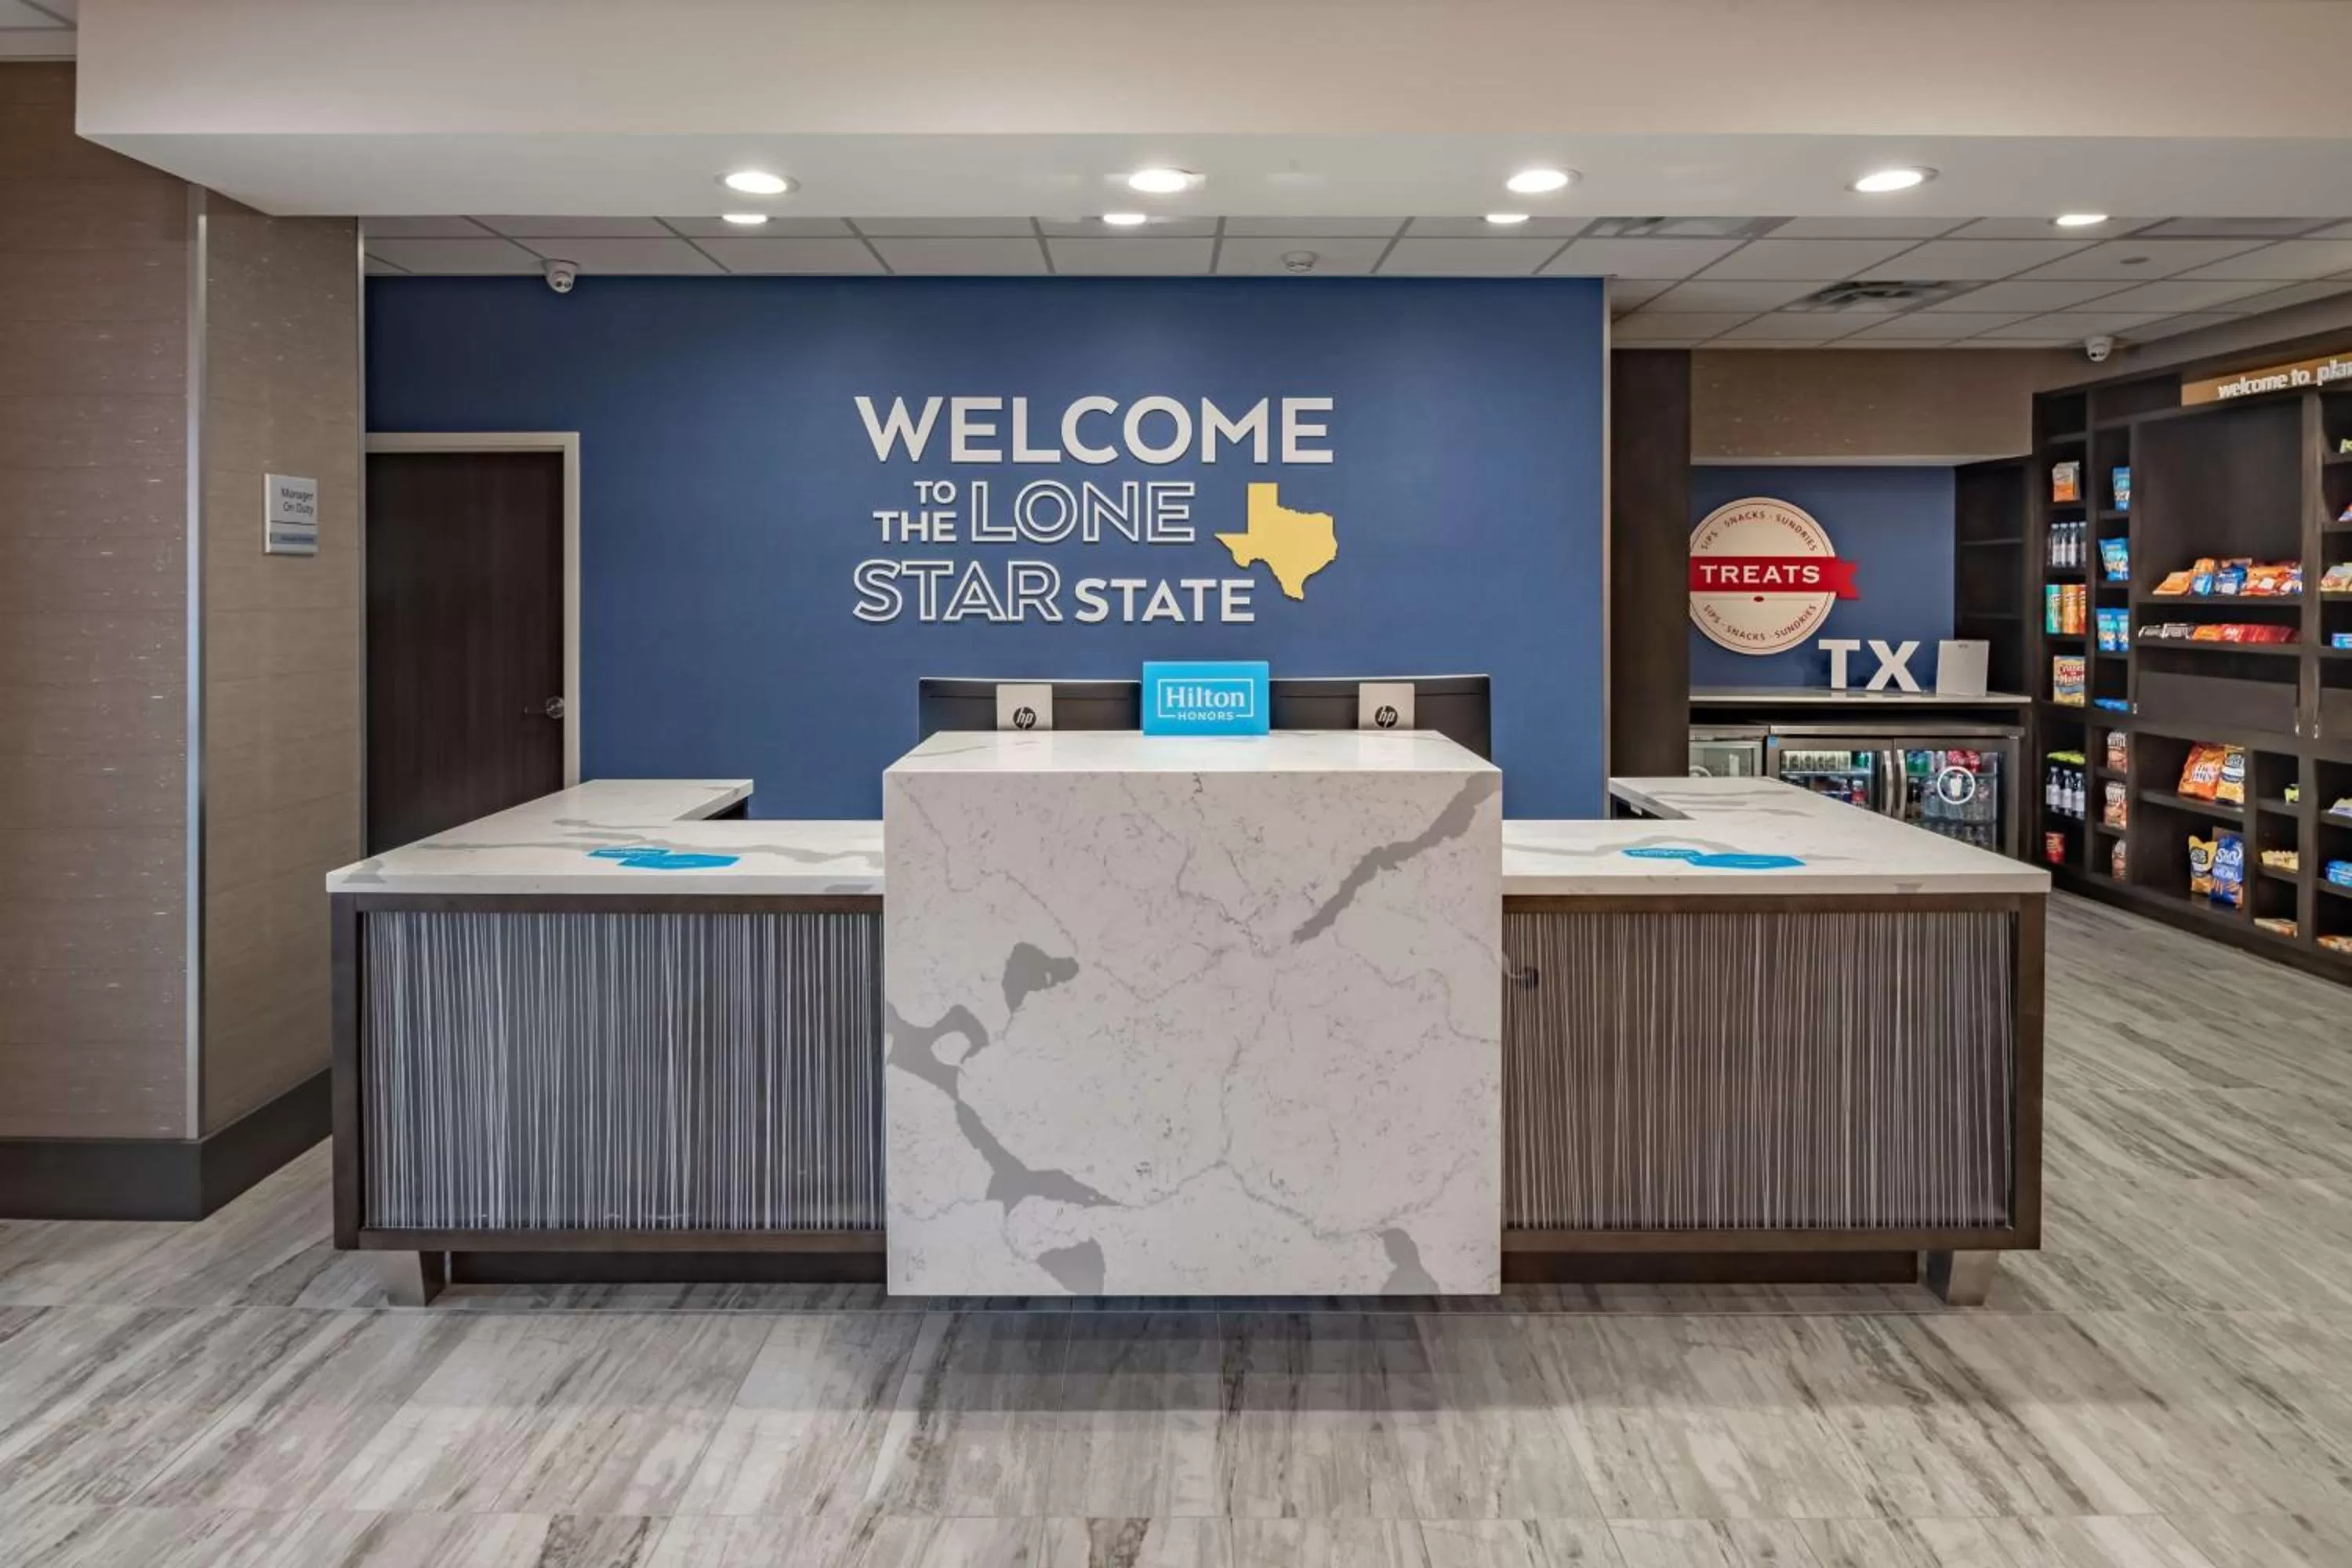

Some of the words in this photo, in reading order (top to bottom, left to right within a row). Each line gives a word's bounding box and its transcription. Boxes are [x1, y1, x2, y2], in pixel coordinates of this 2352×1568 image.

[2218, 373, 2288, 398] welcome
[2290, 368, 2310, 386] to
[854, 396, 1334, 464] WELCOME
[281, 488, 314, 502] Manager
[914, 480, 956, 505] TO
[296, 503, 314, 517] Duty
[873, 511, 958, 543] THE
[971, 480, 1196, 543] LONE
[1700, 531, 1718, 550] SIPS
[1725, 510, 1765, 528] SNACKS
[1776, 514, 1817, 551] SUNDRIES
[1700, 564, 1820, 584] TREATS
[853, 560, 1063, 621] STAR
[1075, 579, 1255, 622] STATE
[1704, 604, 1721, 624] SIPS
[1726, 625, 1766, 641] SNACKS
[1775, 604, 1817, 639] SUNDRIES
[1818, 639, 1922, 693] TX
[1166, 686, 1245, 708] Hilton
[1014, 706, 1036, 728] hp
[1178, 711, 1236, 720] HONORS
[1376, 706, 1396, 728] hp
